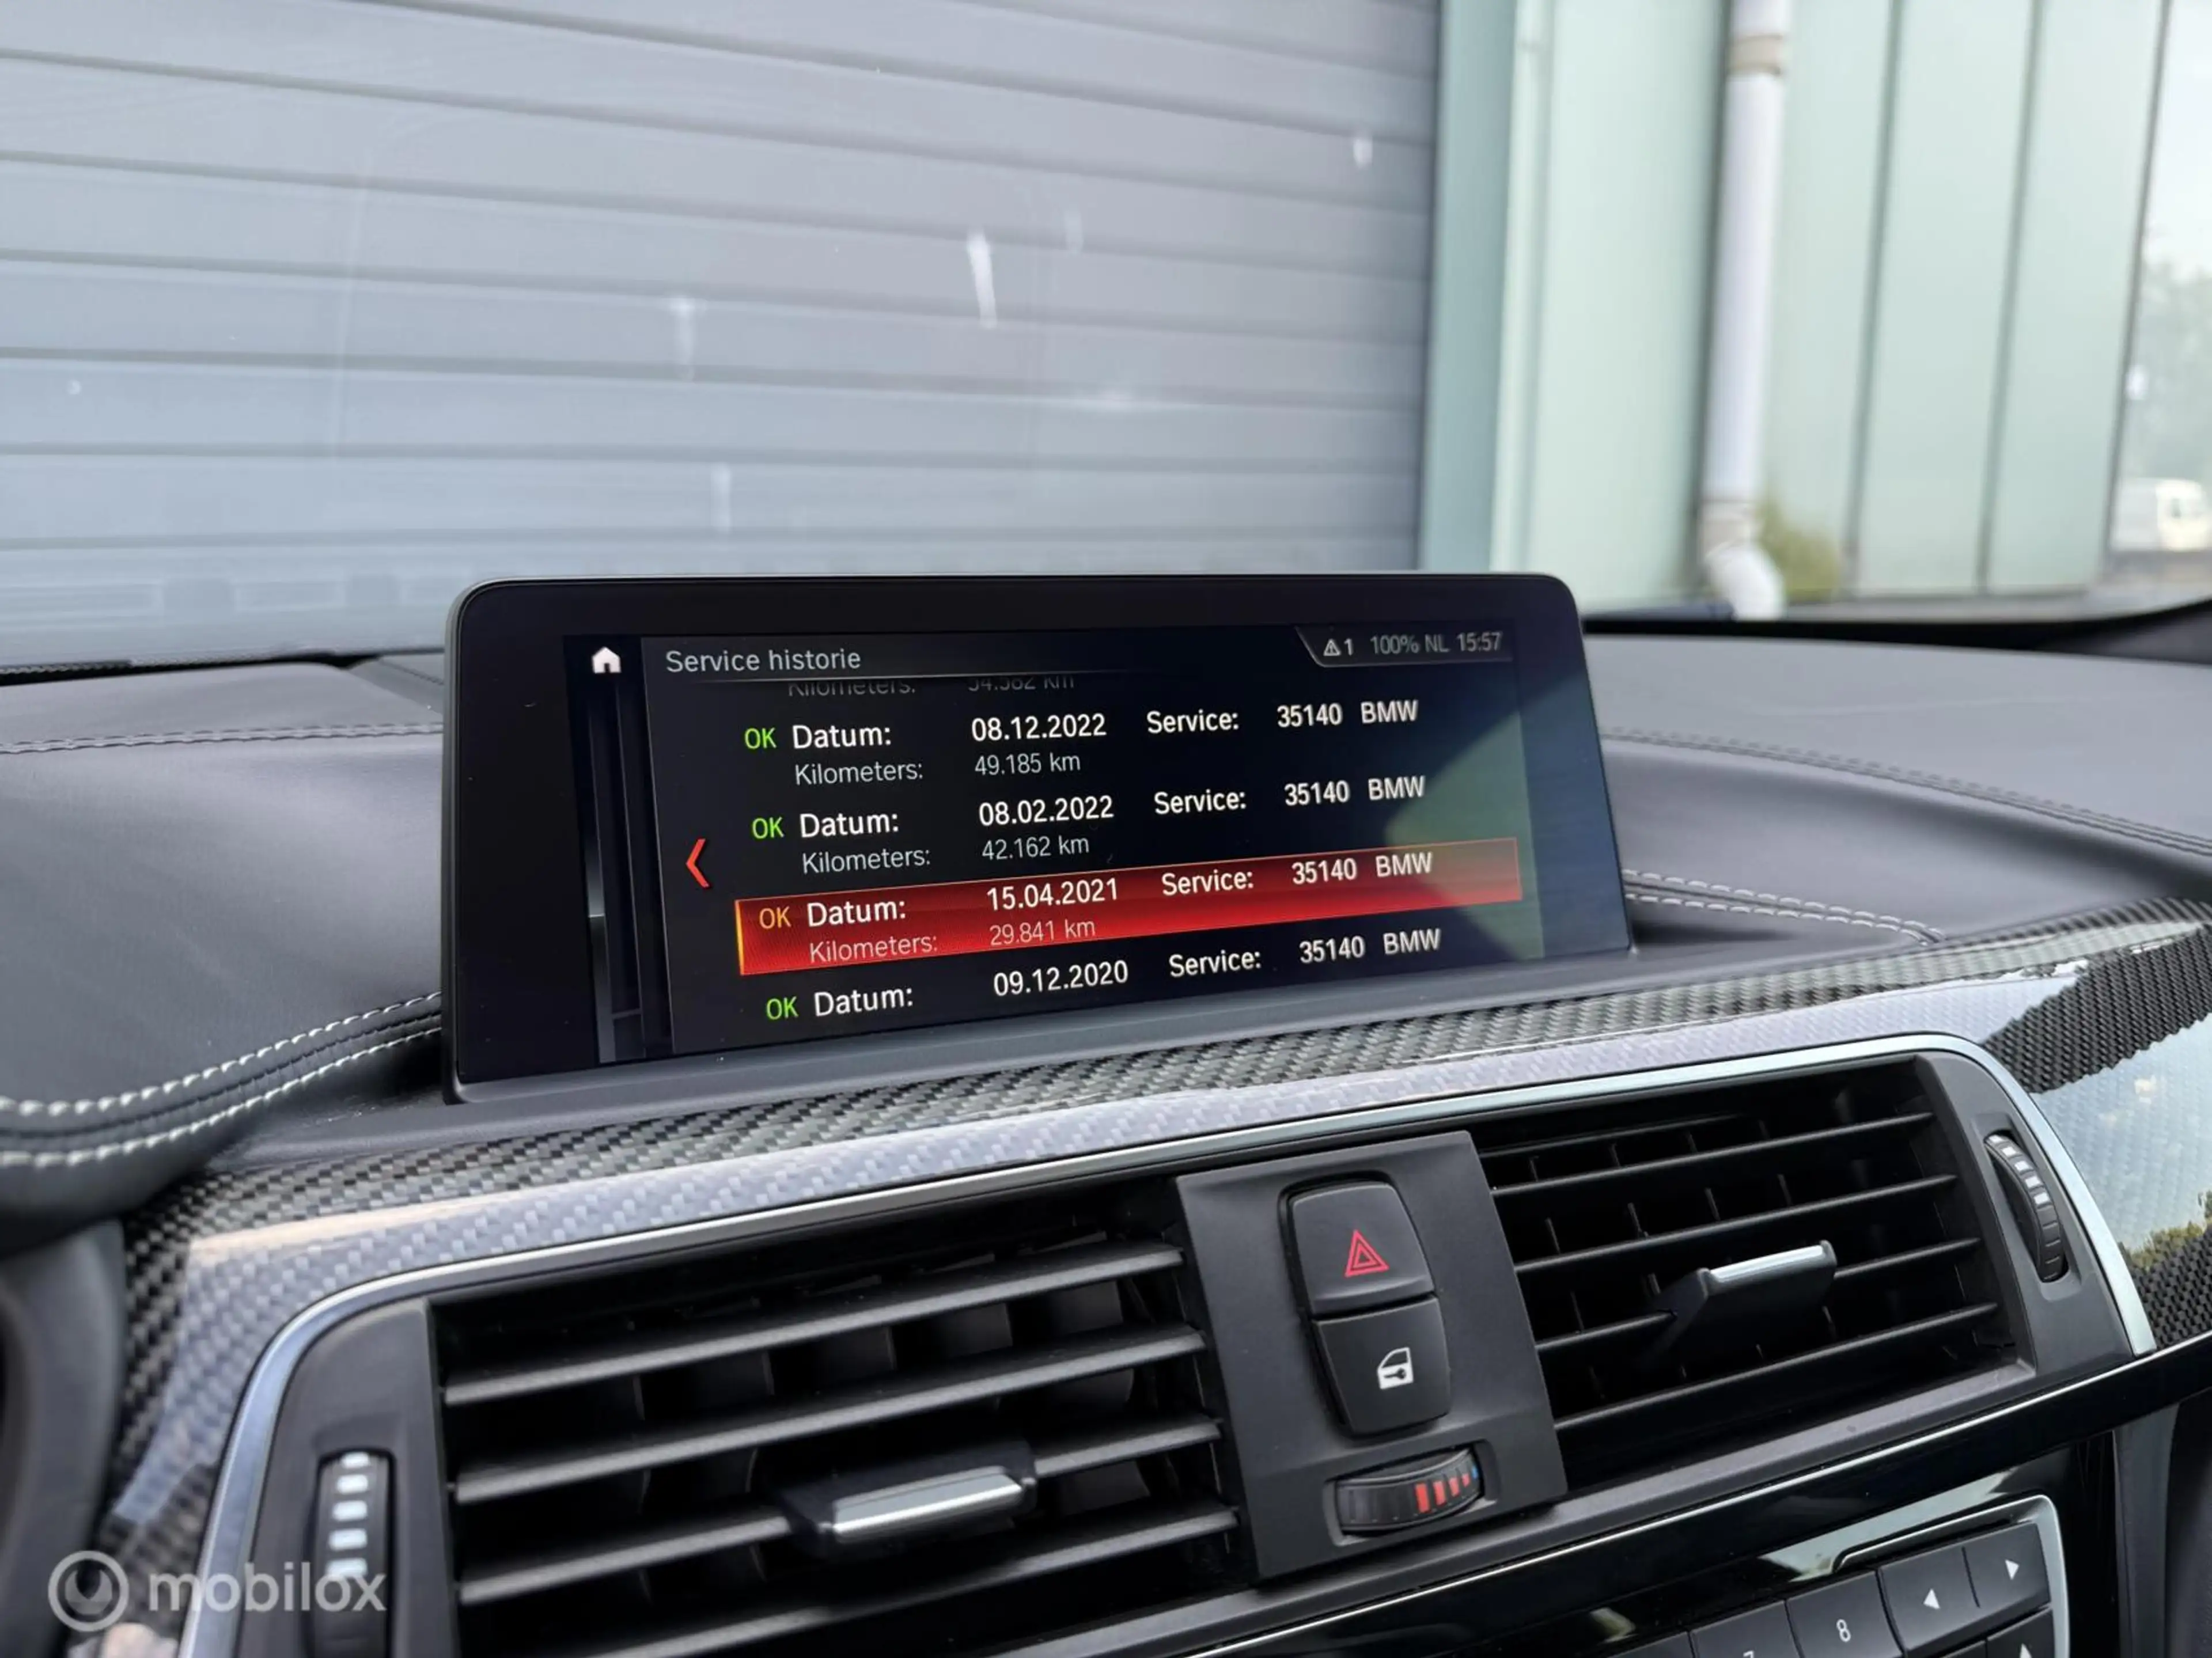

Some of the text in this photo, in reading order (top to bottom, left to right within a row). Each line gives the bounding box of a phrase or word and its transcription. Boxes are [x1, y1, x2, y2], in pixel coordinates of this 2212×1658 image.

[666, 648, 861, 673] Service historie
[1343, 631, 1502, 656] 1 100% NL 15:57
[744, 700, 1418, 749] OK Datum: 08.12.2022 Service: 35140 BMW
[795, 752, 1081, 785] Kilometers: 49.185 km
[752, 775, 1425, 839] OK Datum: 08.02.2022 Service: 35140 BMW
[802, 835, 1089, 874] Kilometers: 42.162 km
[759, 851, 1433, 929] OK Datum: 15.04.2021 Service: 35140 BMW
[809, 919, 1096, 963] Kilometers: 29.841 km
[766, 928, 1441, 1020] OK Datum: 09.12.2020 Service: 35140 BMW
[1836, 1618, 1851, 1642] 8
